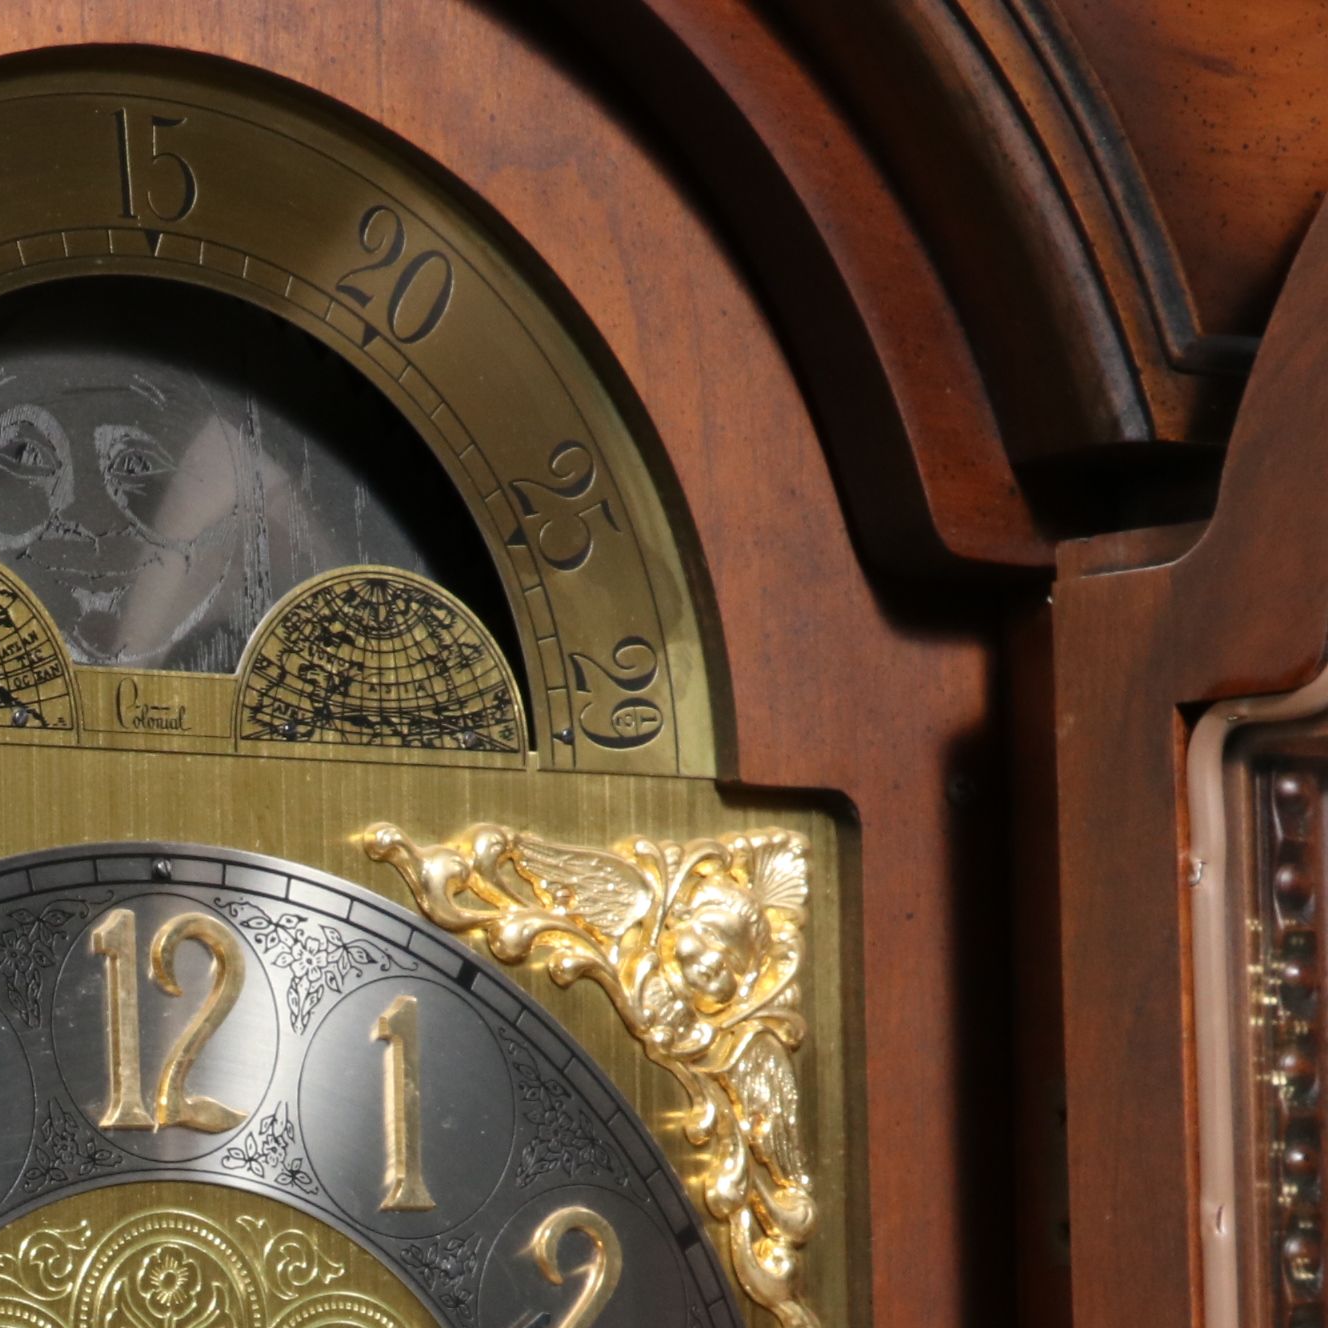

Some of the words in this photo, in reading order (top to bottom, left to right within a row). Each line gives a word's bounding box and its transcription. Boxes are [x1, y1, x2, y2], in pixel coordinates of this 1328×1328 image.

[112, 107, 198, 221] 15
[335, 205, 454, 344] 20
[508, 440, 622, 573] 25
[116, 677, 192, 733] Colonial
[91, 909, 249, 1133] 12
[375, 995, 437, 1211] 1
